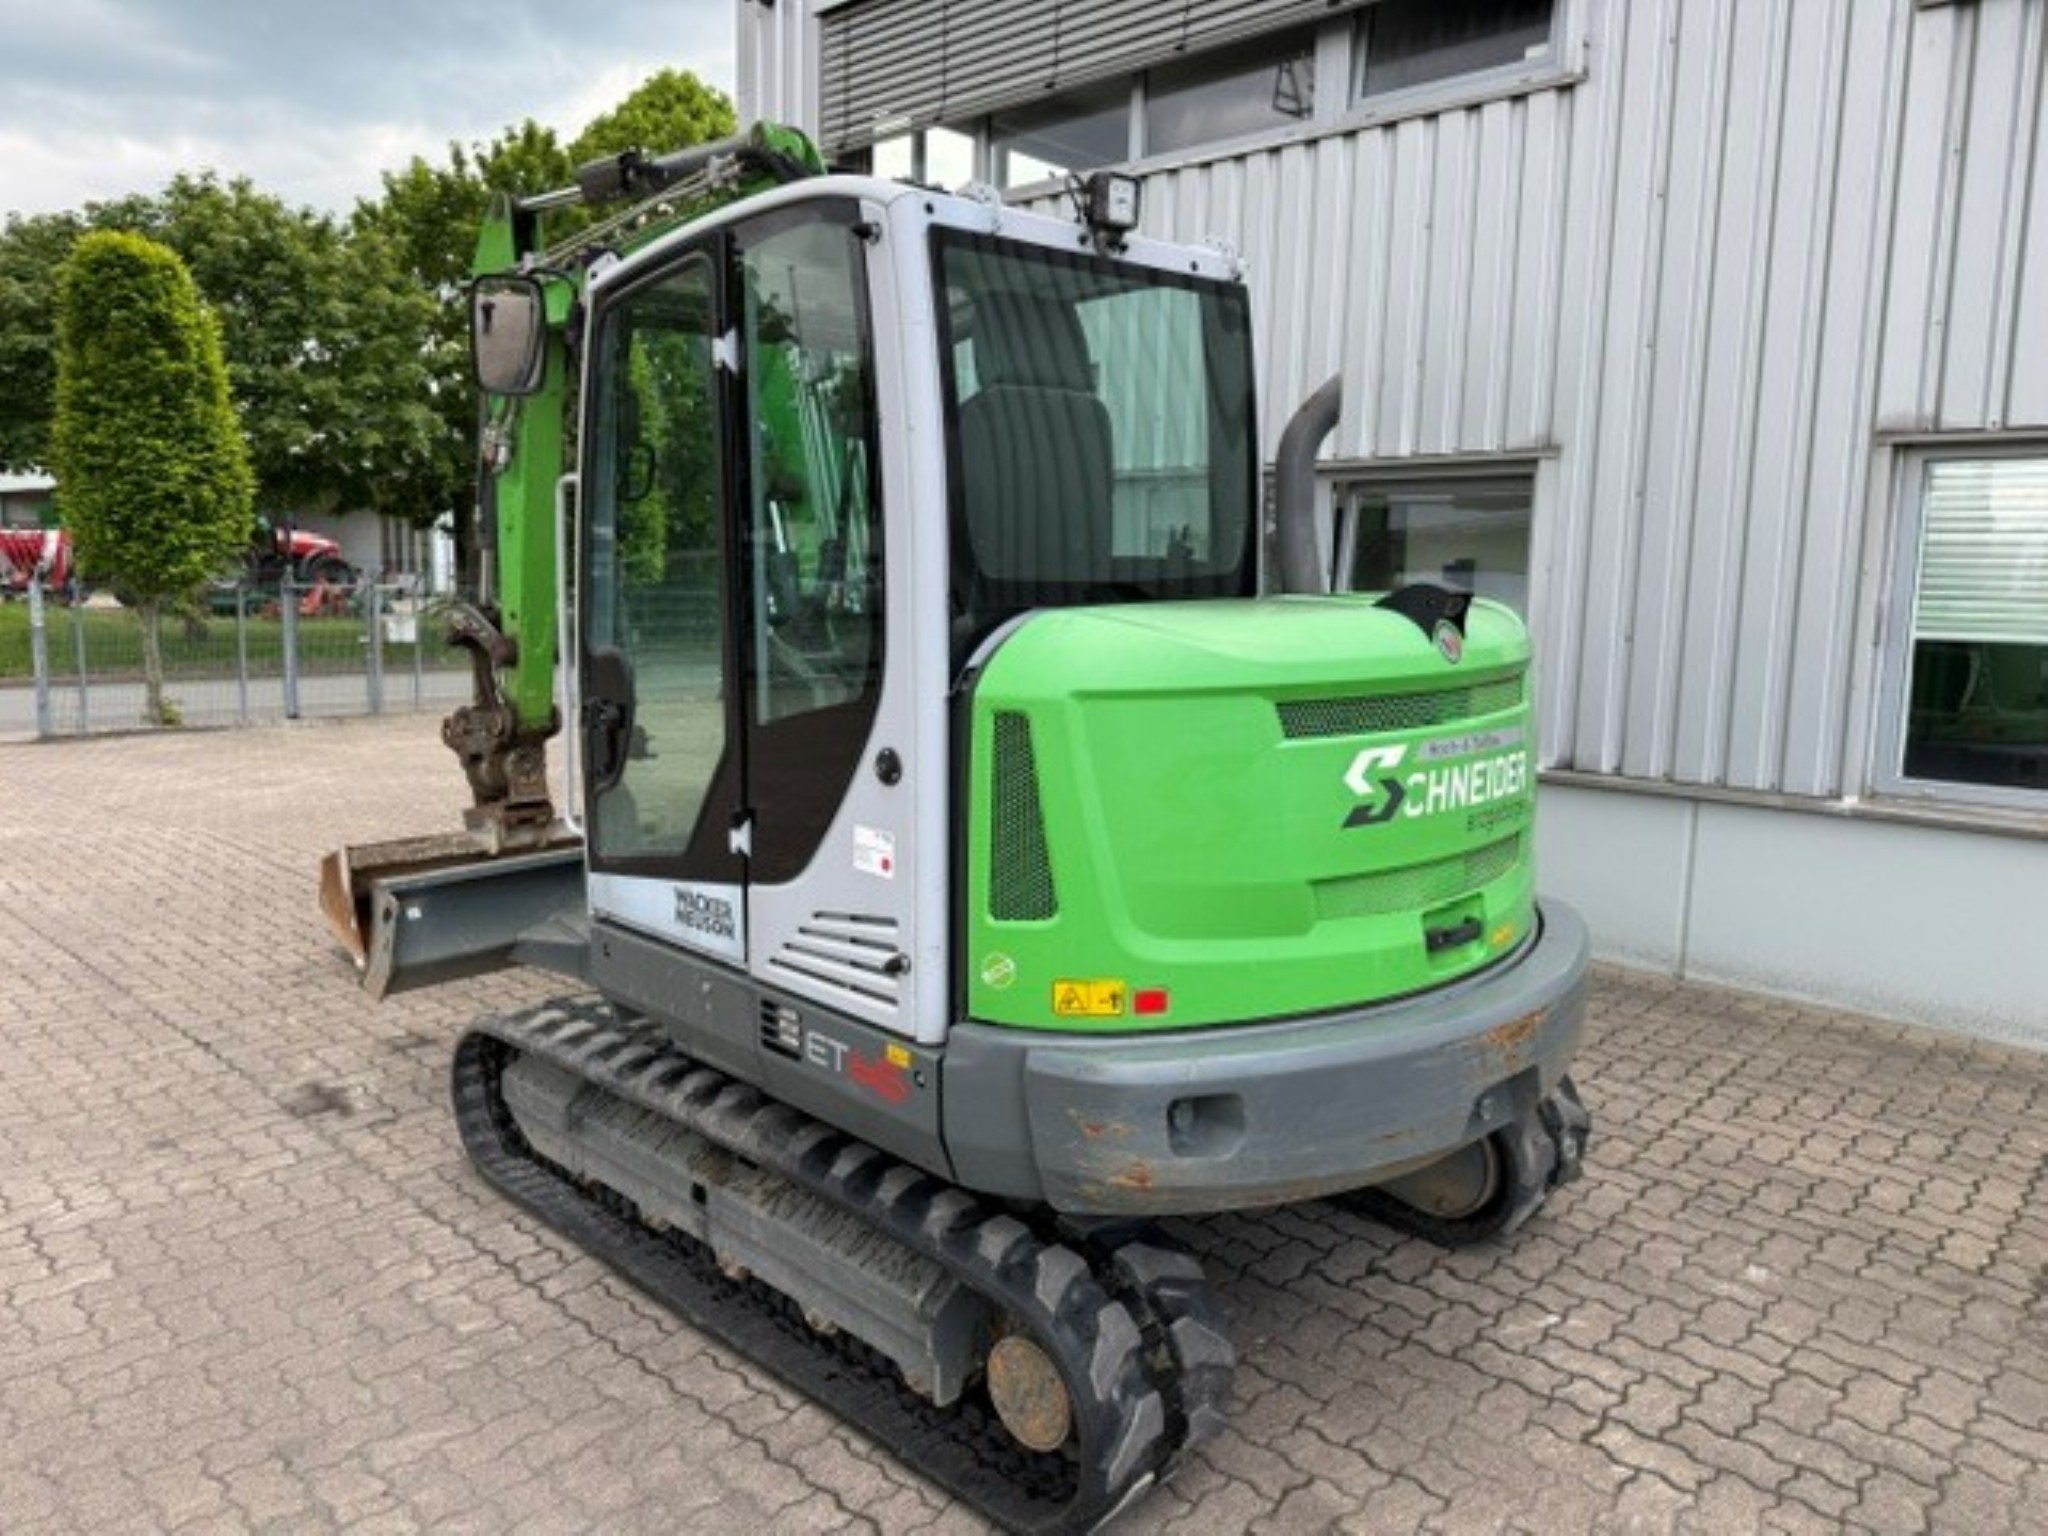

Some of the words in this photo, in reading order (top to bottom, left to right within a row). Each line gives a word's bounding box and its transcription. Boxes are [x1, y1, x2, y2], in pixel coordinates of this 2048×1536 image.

[1342, 744, 1527, 829] SCHNEIDER
[674, 886, 732, 919] WACKER
[675, 909, 736, 941] NEUSON
